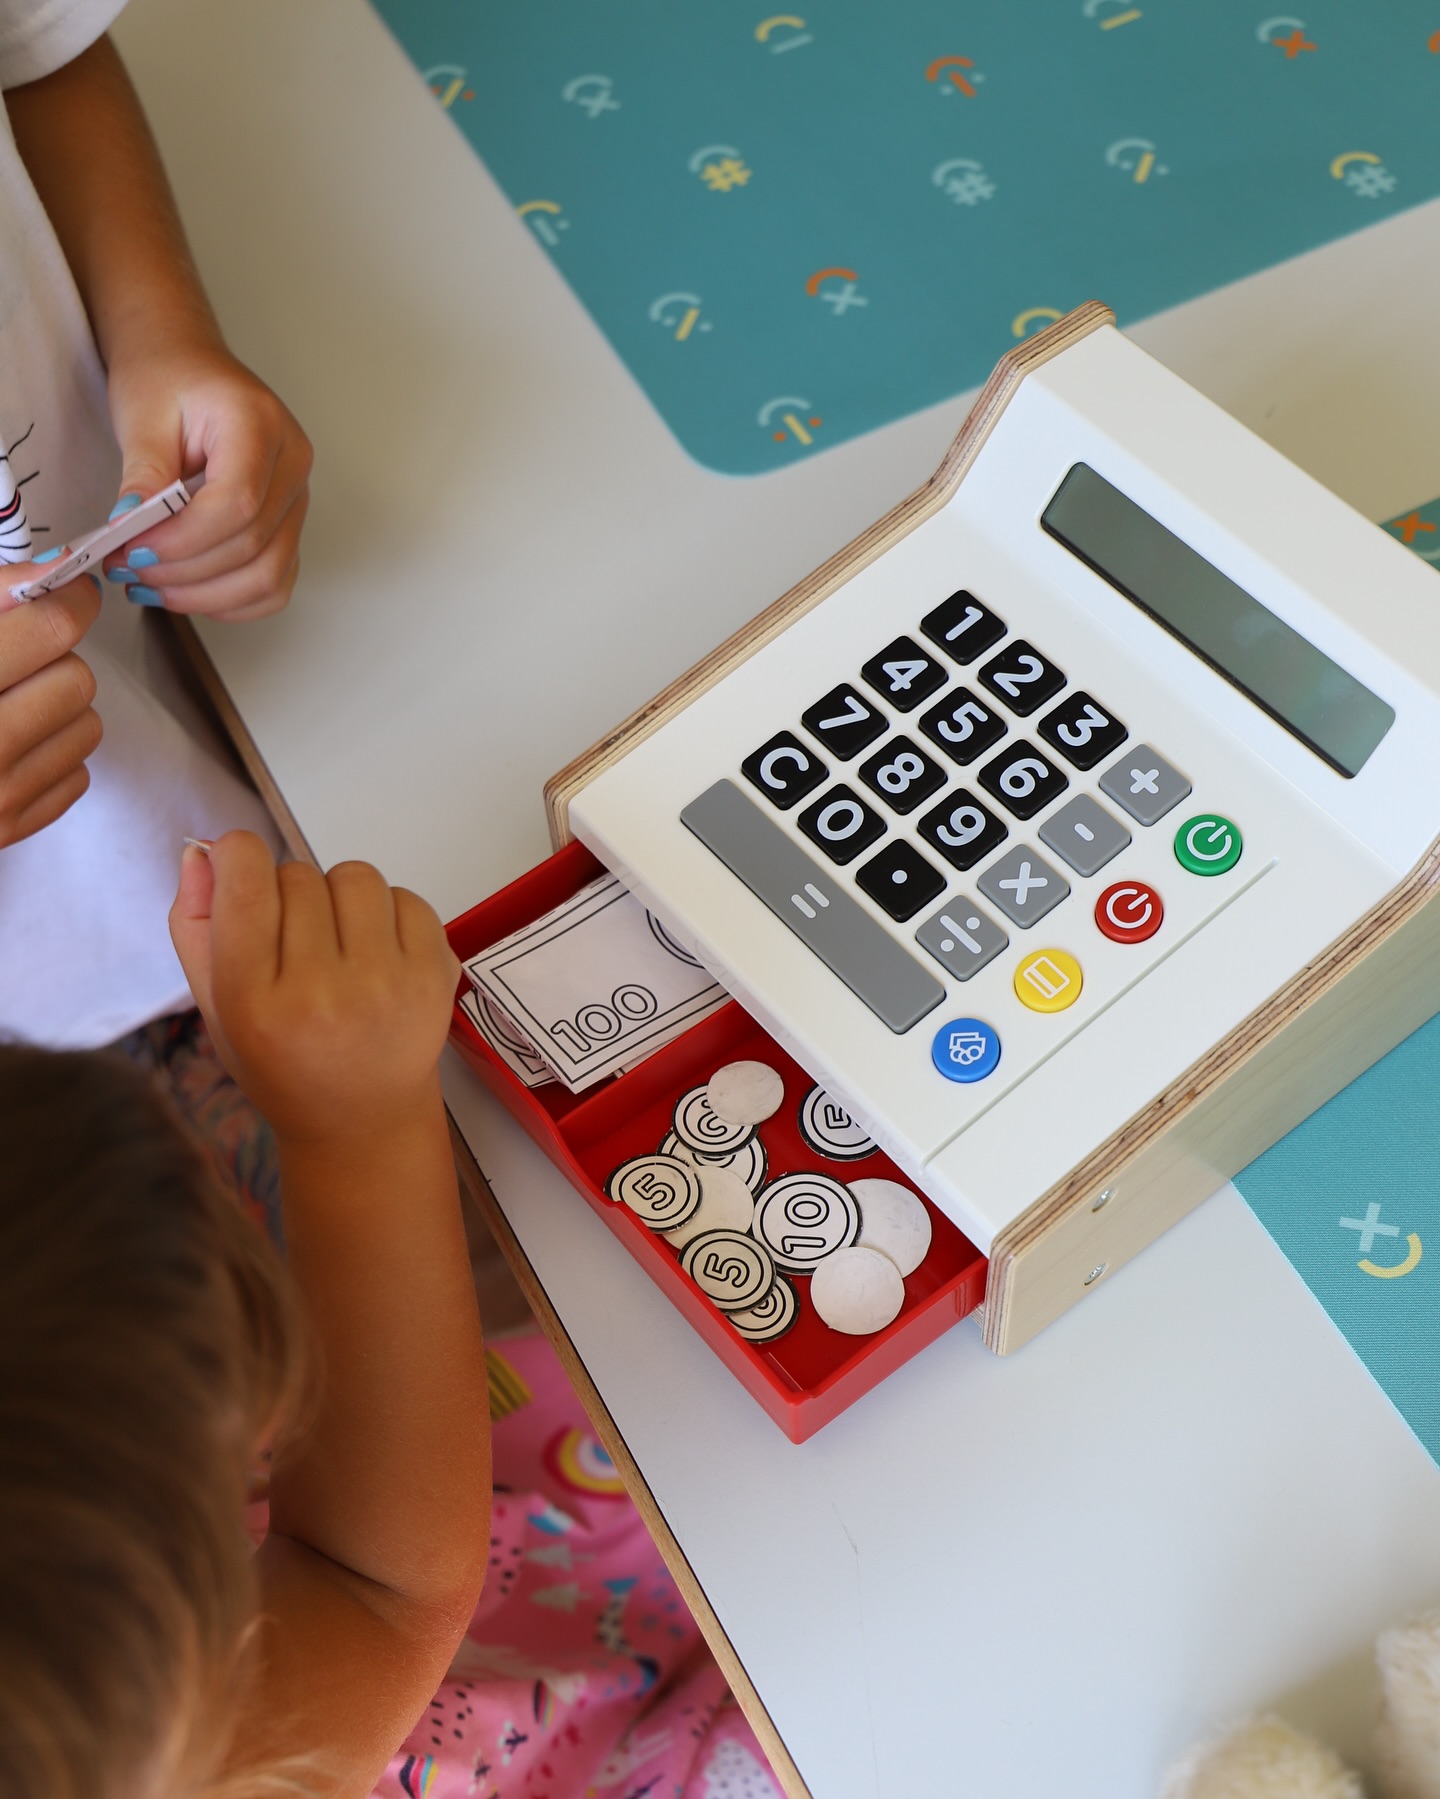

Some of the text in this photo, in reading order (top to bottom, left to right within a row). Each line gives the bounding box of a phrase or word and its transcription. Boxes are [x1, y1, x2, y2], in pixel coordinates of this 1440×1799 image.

[946, 607, 983, 640] 1
[883, 660, 928, 691] 4
[994, 656, 1043, 696] 2
[819, 696, 869, 729] 7
[938, 702, 988, 742] 5
[1058, 705, 1108, 746] 3
[761, 748, 809, 789] C
[877, 753, 924, 793] 8
[1000, 759, 1048, 797] 6
[818, 800, 863, 840] 0
[937, 806, 985, 846] 9
[550, 983, 658, 1052] 100
[632, 1172, 676, 1211] 5
[782, 1192, 830, 1255] 10
[703, 1252, 750, 1288] 5
